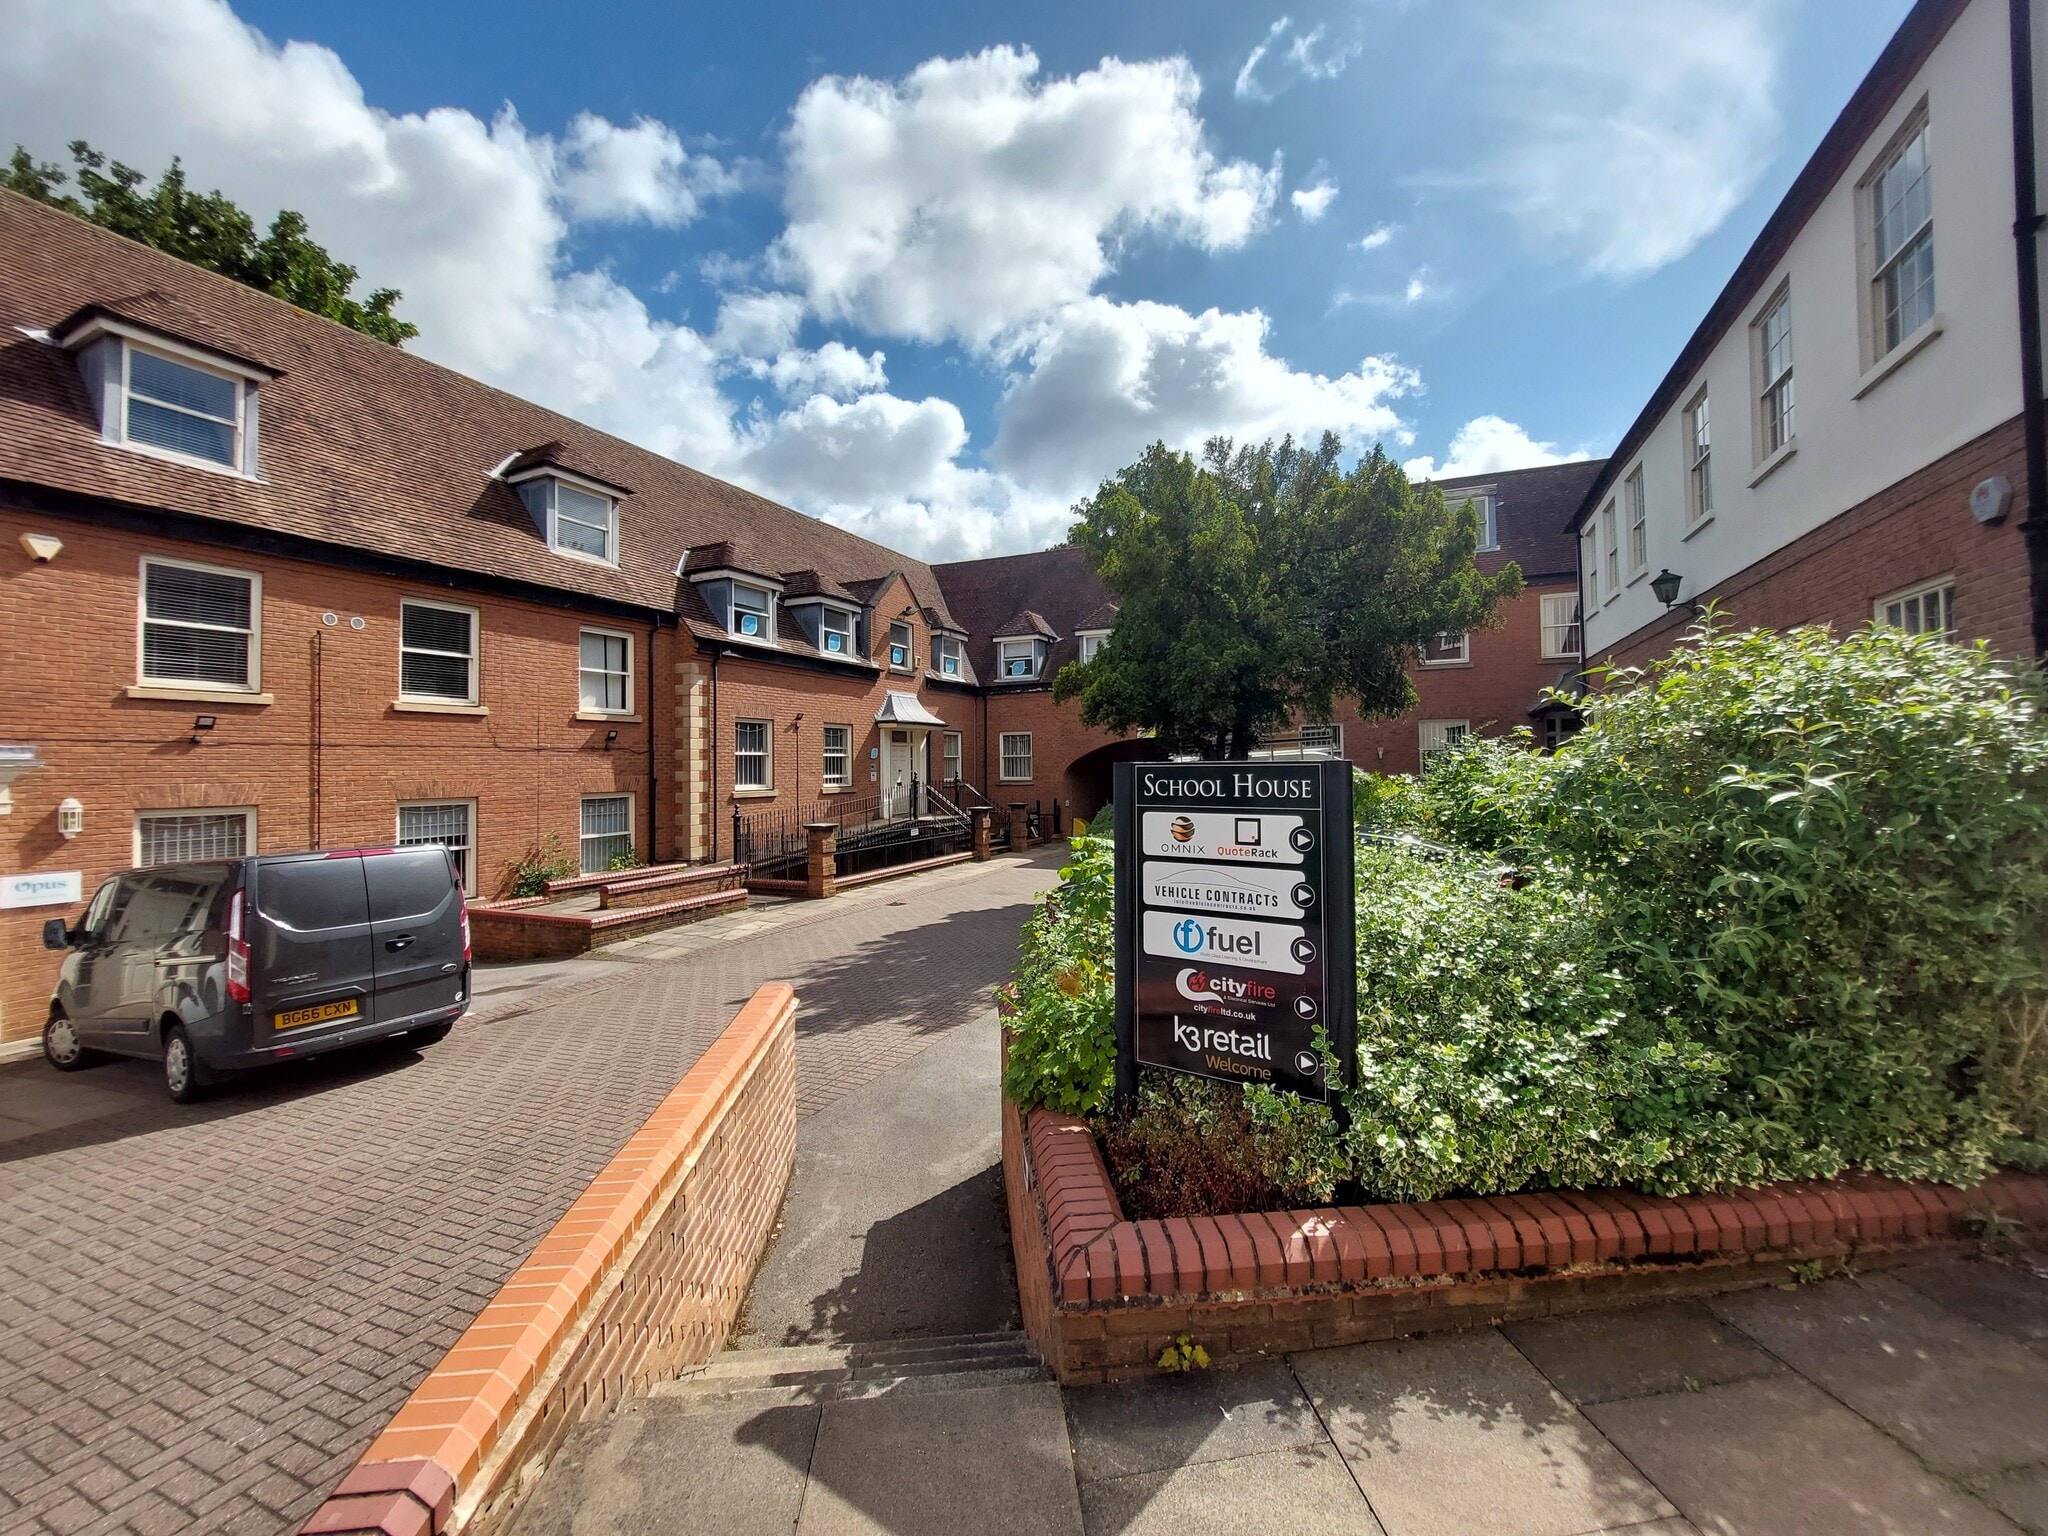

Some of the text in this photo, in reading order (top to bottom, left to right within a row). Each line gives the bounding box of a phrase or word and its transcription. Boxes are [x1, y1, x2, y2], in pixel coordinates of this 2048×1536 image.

[1161, 843, 1205, 855] OMNIX
[1217, 846, 1278, 859] QuoteRack
[1154, 885, 1279, 907] VEHICLE CONTRACTS
[1206, 926, 1261, 956] fuel
[1209, 976, 1276, 999] cityfire
[282, 1001, 351, 1026] BG66 CXN
[1193, 1003, 1257, 1021] cityfireltd.co.uk
[1205, 1054, 1272, 1081] Welcome
